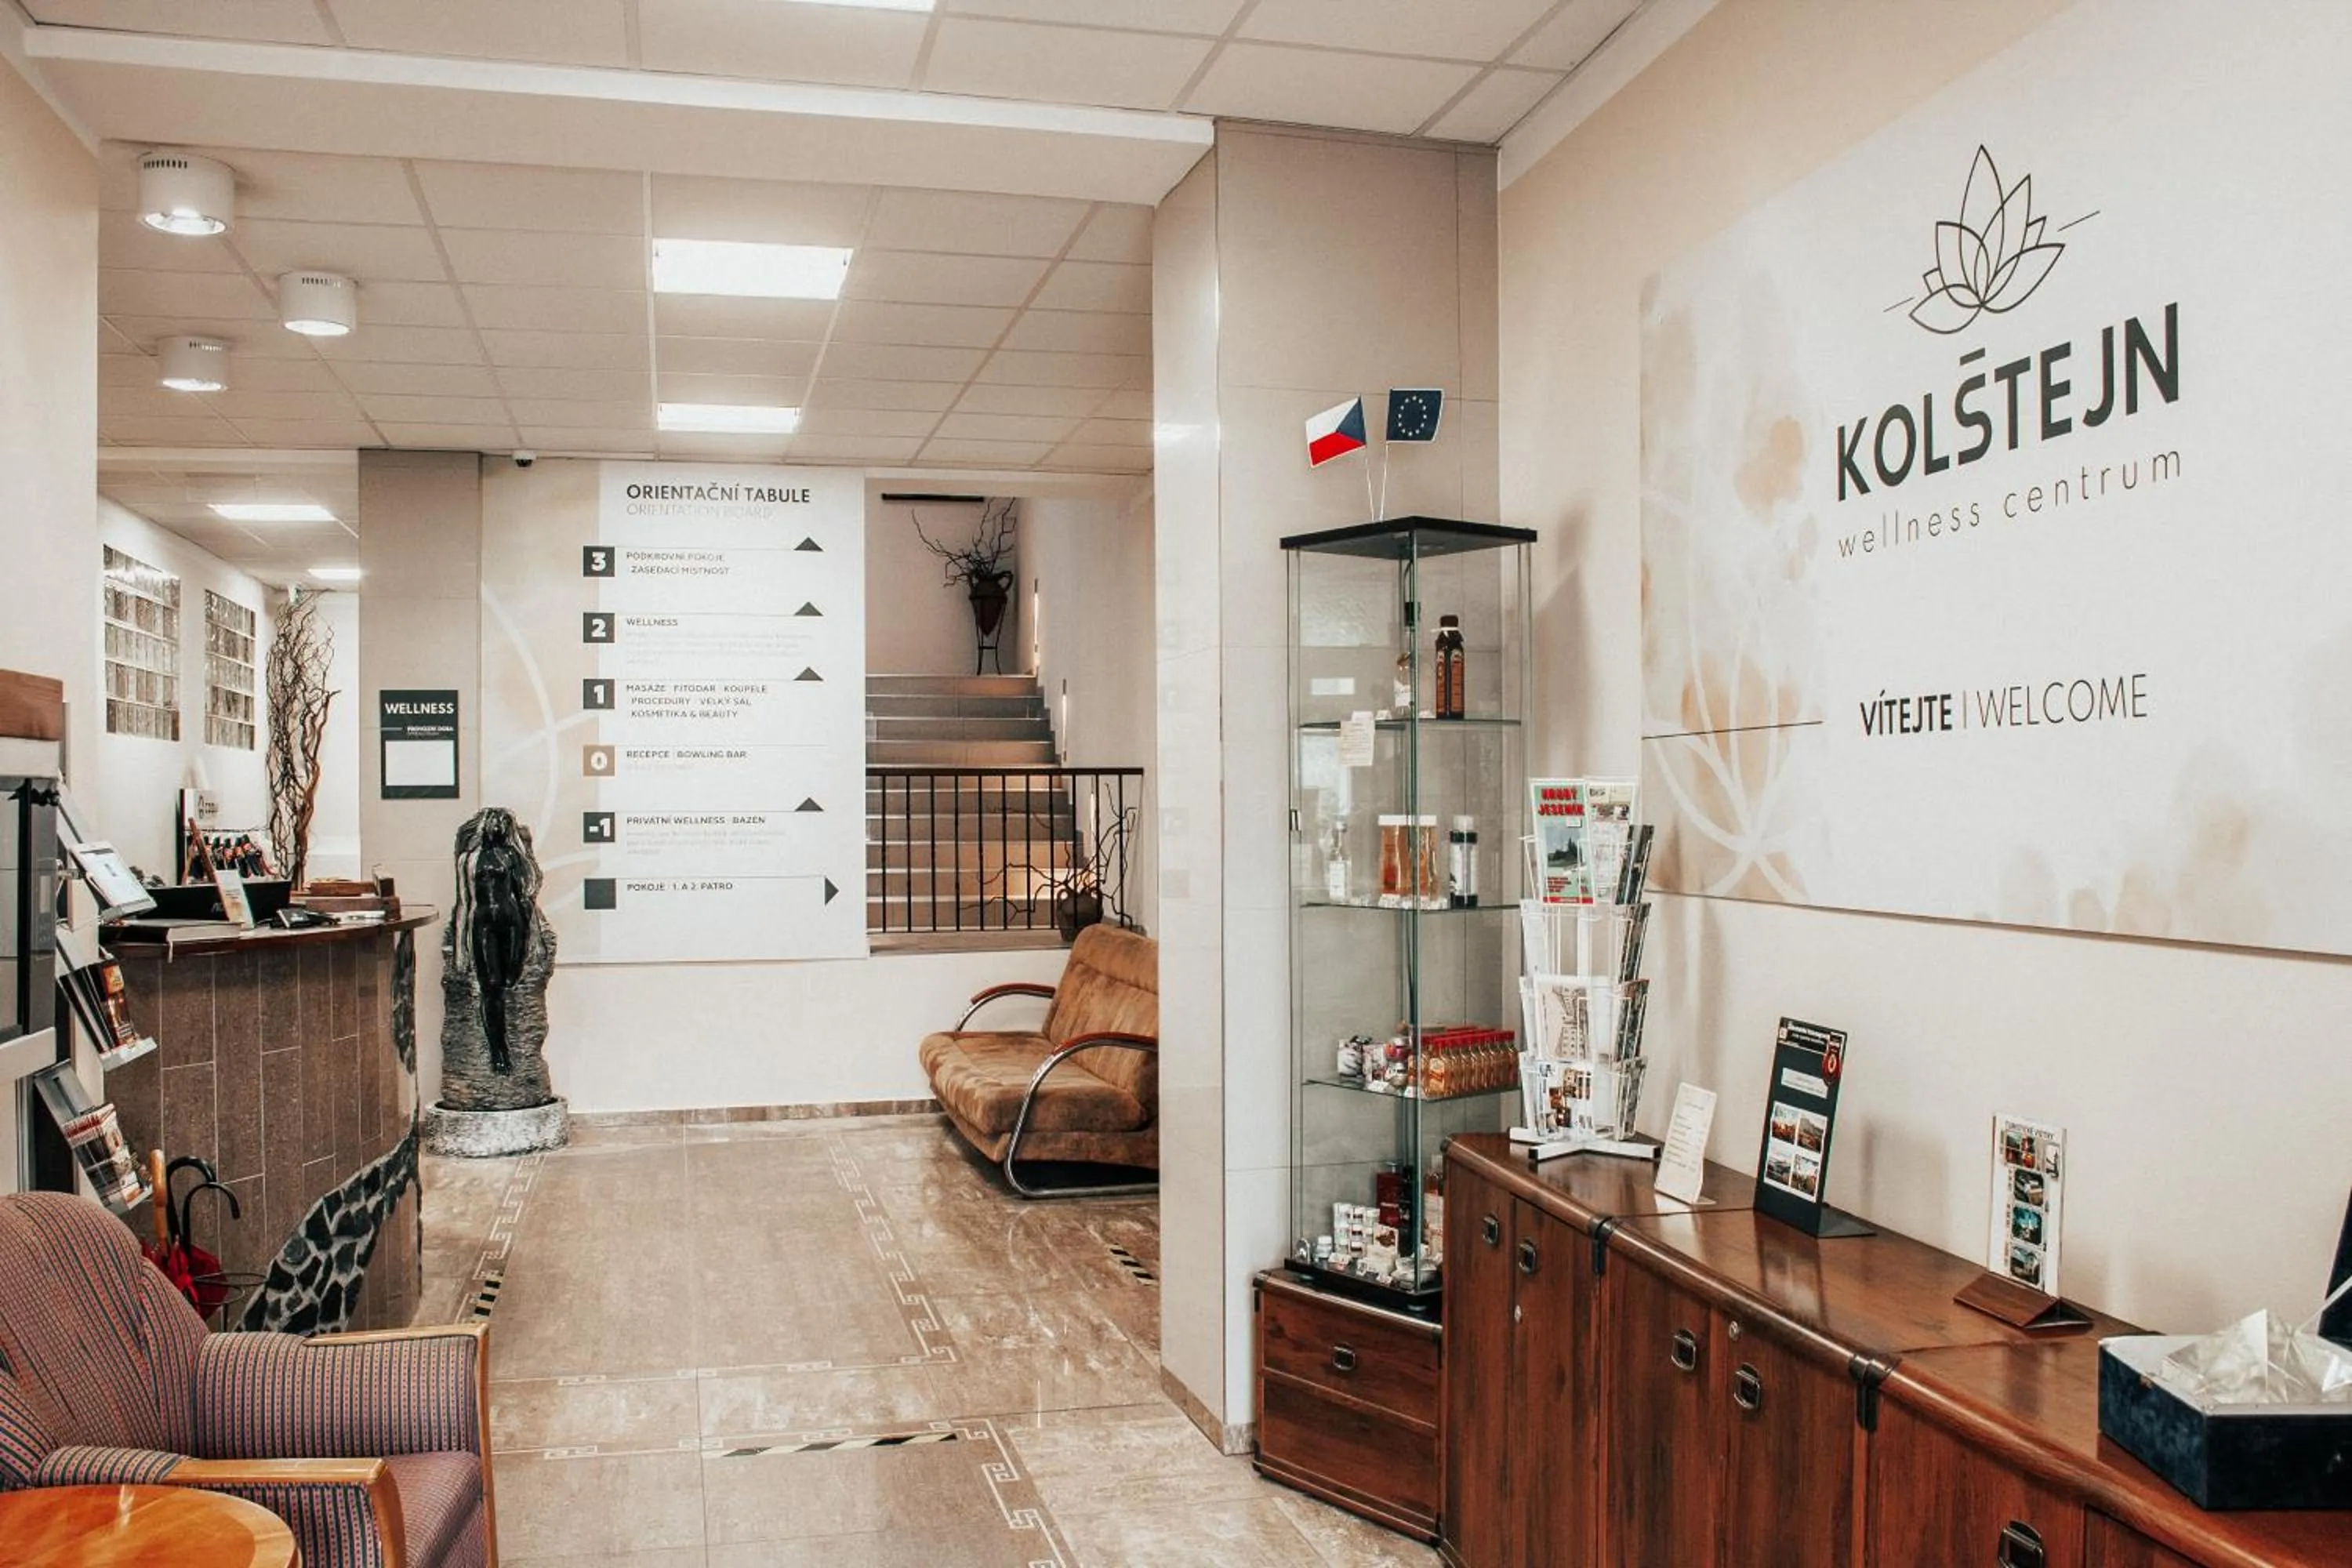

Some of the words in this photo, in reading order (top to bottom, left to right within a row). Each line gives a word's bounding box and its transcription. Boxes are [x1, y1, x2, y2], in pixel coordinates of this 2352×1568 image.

[626, 482, 739, 501] ORIENTAČNÍ
[744, 487, 811, 503] TABULE
[1838, 501, 1981, 558] wellness
[2002, 449, 2181, 519] centrum
[590, 551, 607, 572] 3
[590, 618, 607, 638] 2
[626, 618, 679, 627] WELLNESS
[593, 684, 605, 705] 1
[630, 697, 691, 706] PROCEDURY
[384, 702, 455, 715] WELLNESS
[630, 709, 688, 719] KOSMETIKA
[699, 710, 739, 719] BEAUTY
[1859, 689, 1953, 737] VÍTEJTE
[1976, 673, 2148, 730] WELCOME
[590, 750, 608, 771] 0
[626, 750, 670, 759] RECEPCE
[677, 750, 725, 759] BOWLING
[727, 750, 748, 759] BAR
[588, 818, 611, 838] -1
[673, 816, 726, 826] WELLNESS
[626, 883, 666, 892] POKOJE
[700, 882, 734, 891] PATRO
